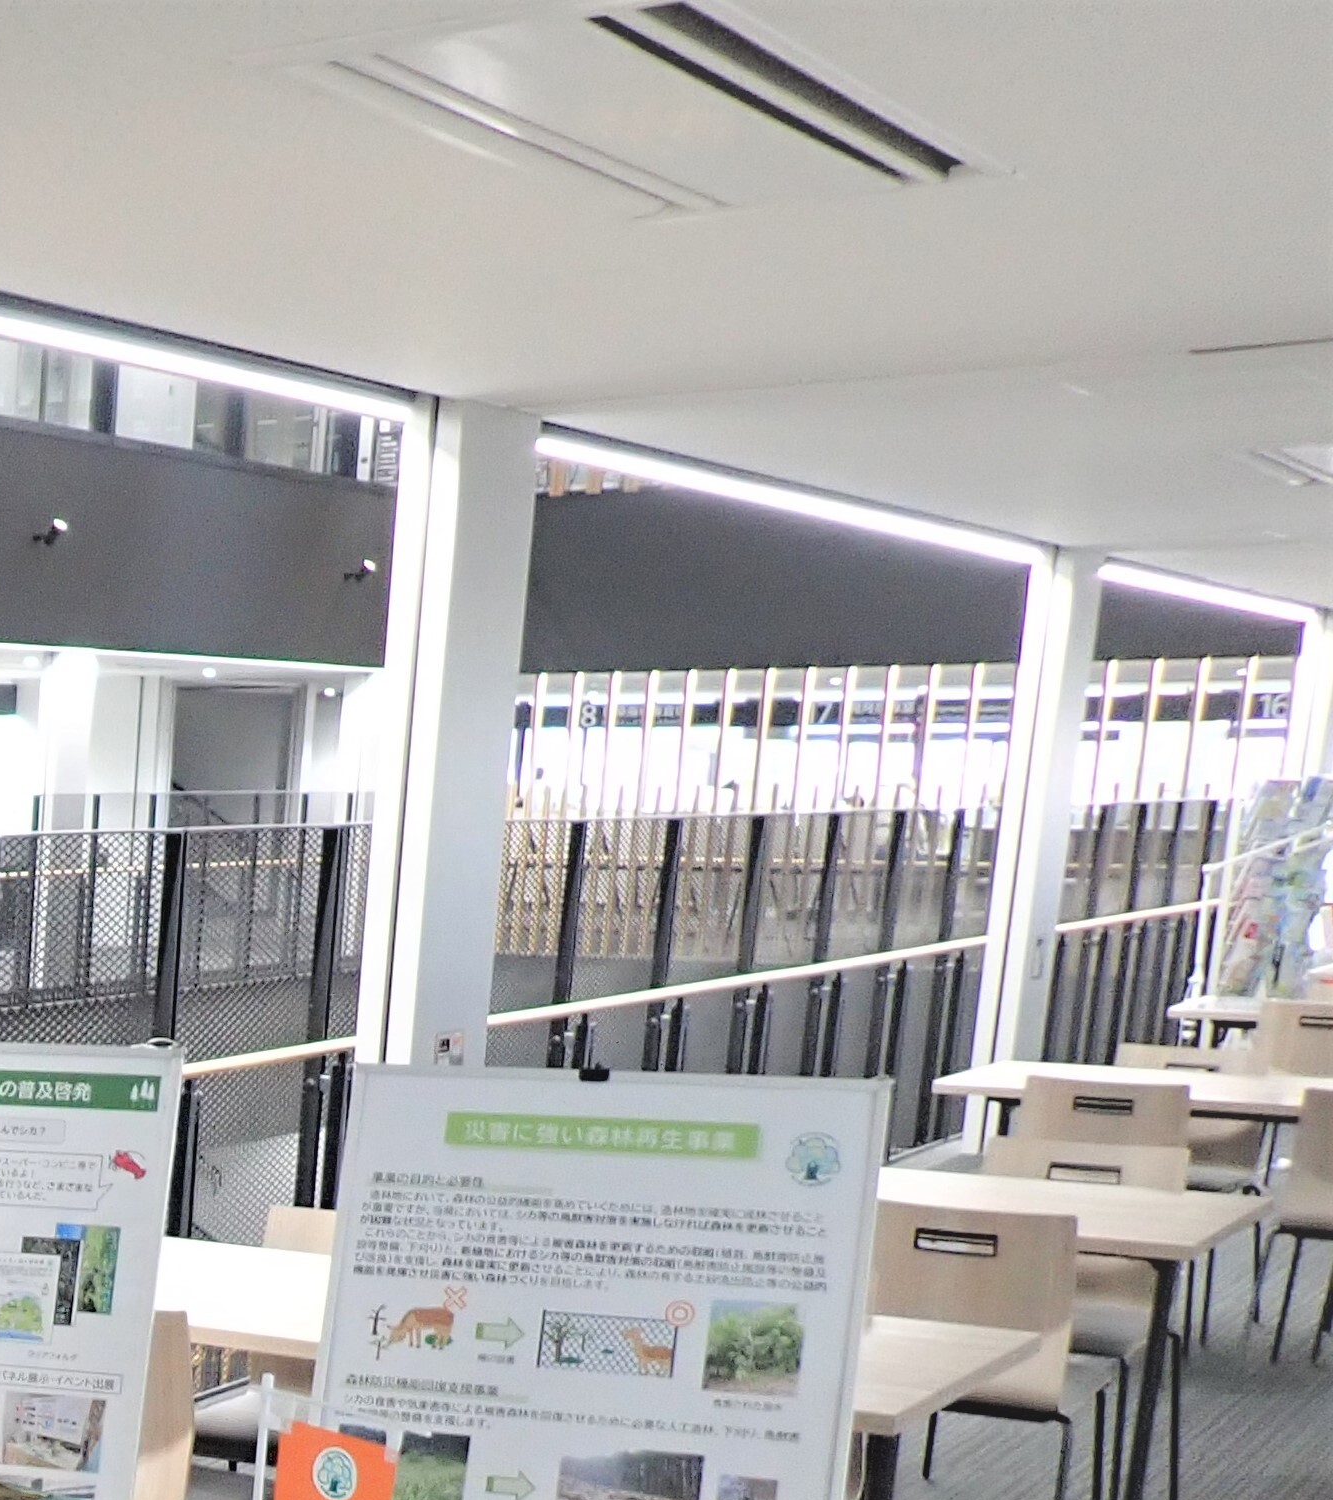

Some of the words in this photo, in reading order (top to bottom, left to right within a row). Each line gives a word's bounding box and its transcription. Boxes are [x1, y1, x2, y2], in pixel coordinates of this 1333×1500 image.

[463, 1120, 736, 1152] 災害に強い森林再生事業
